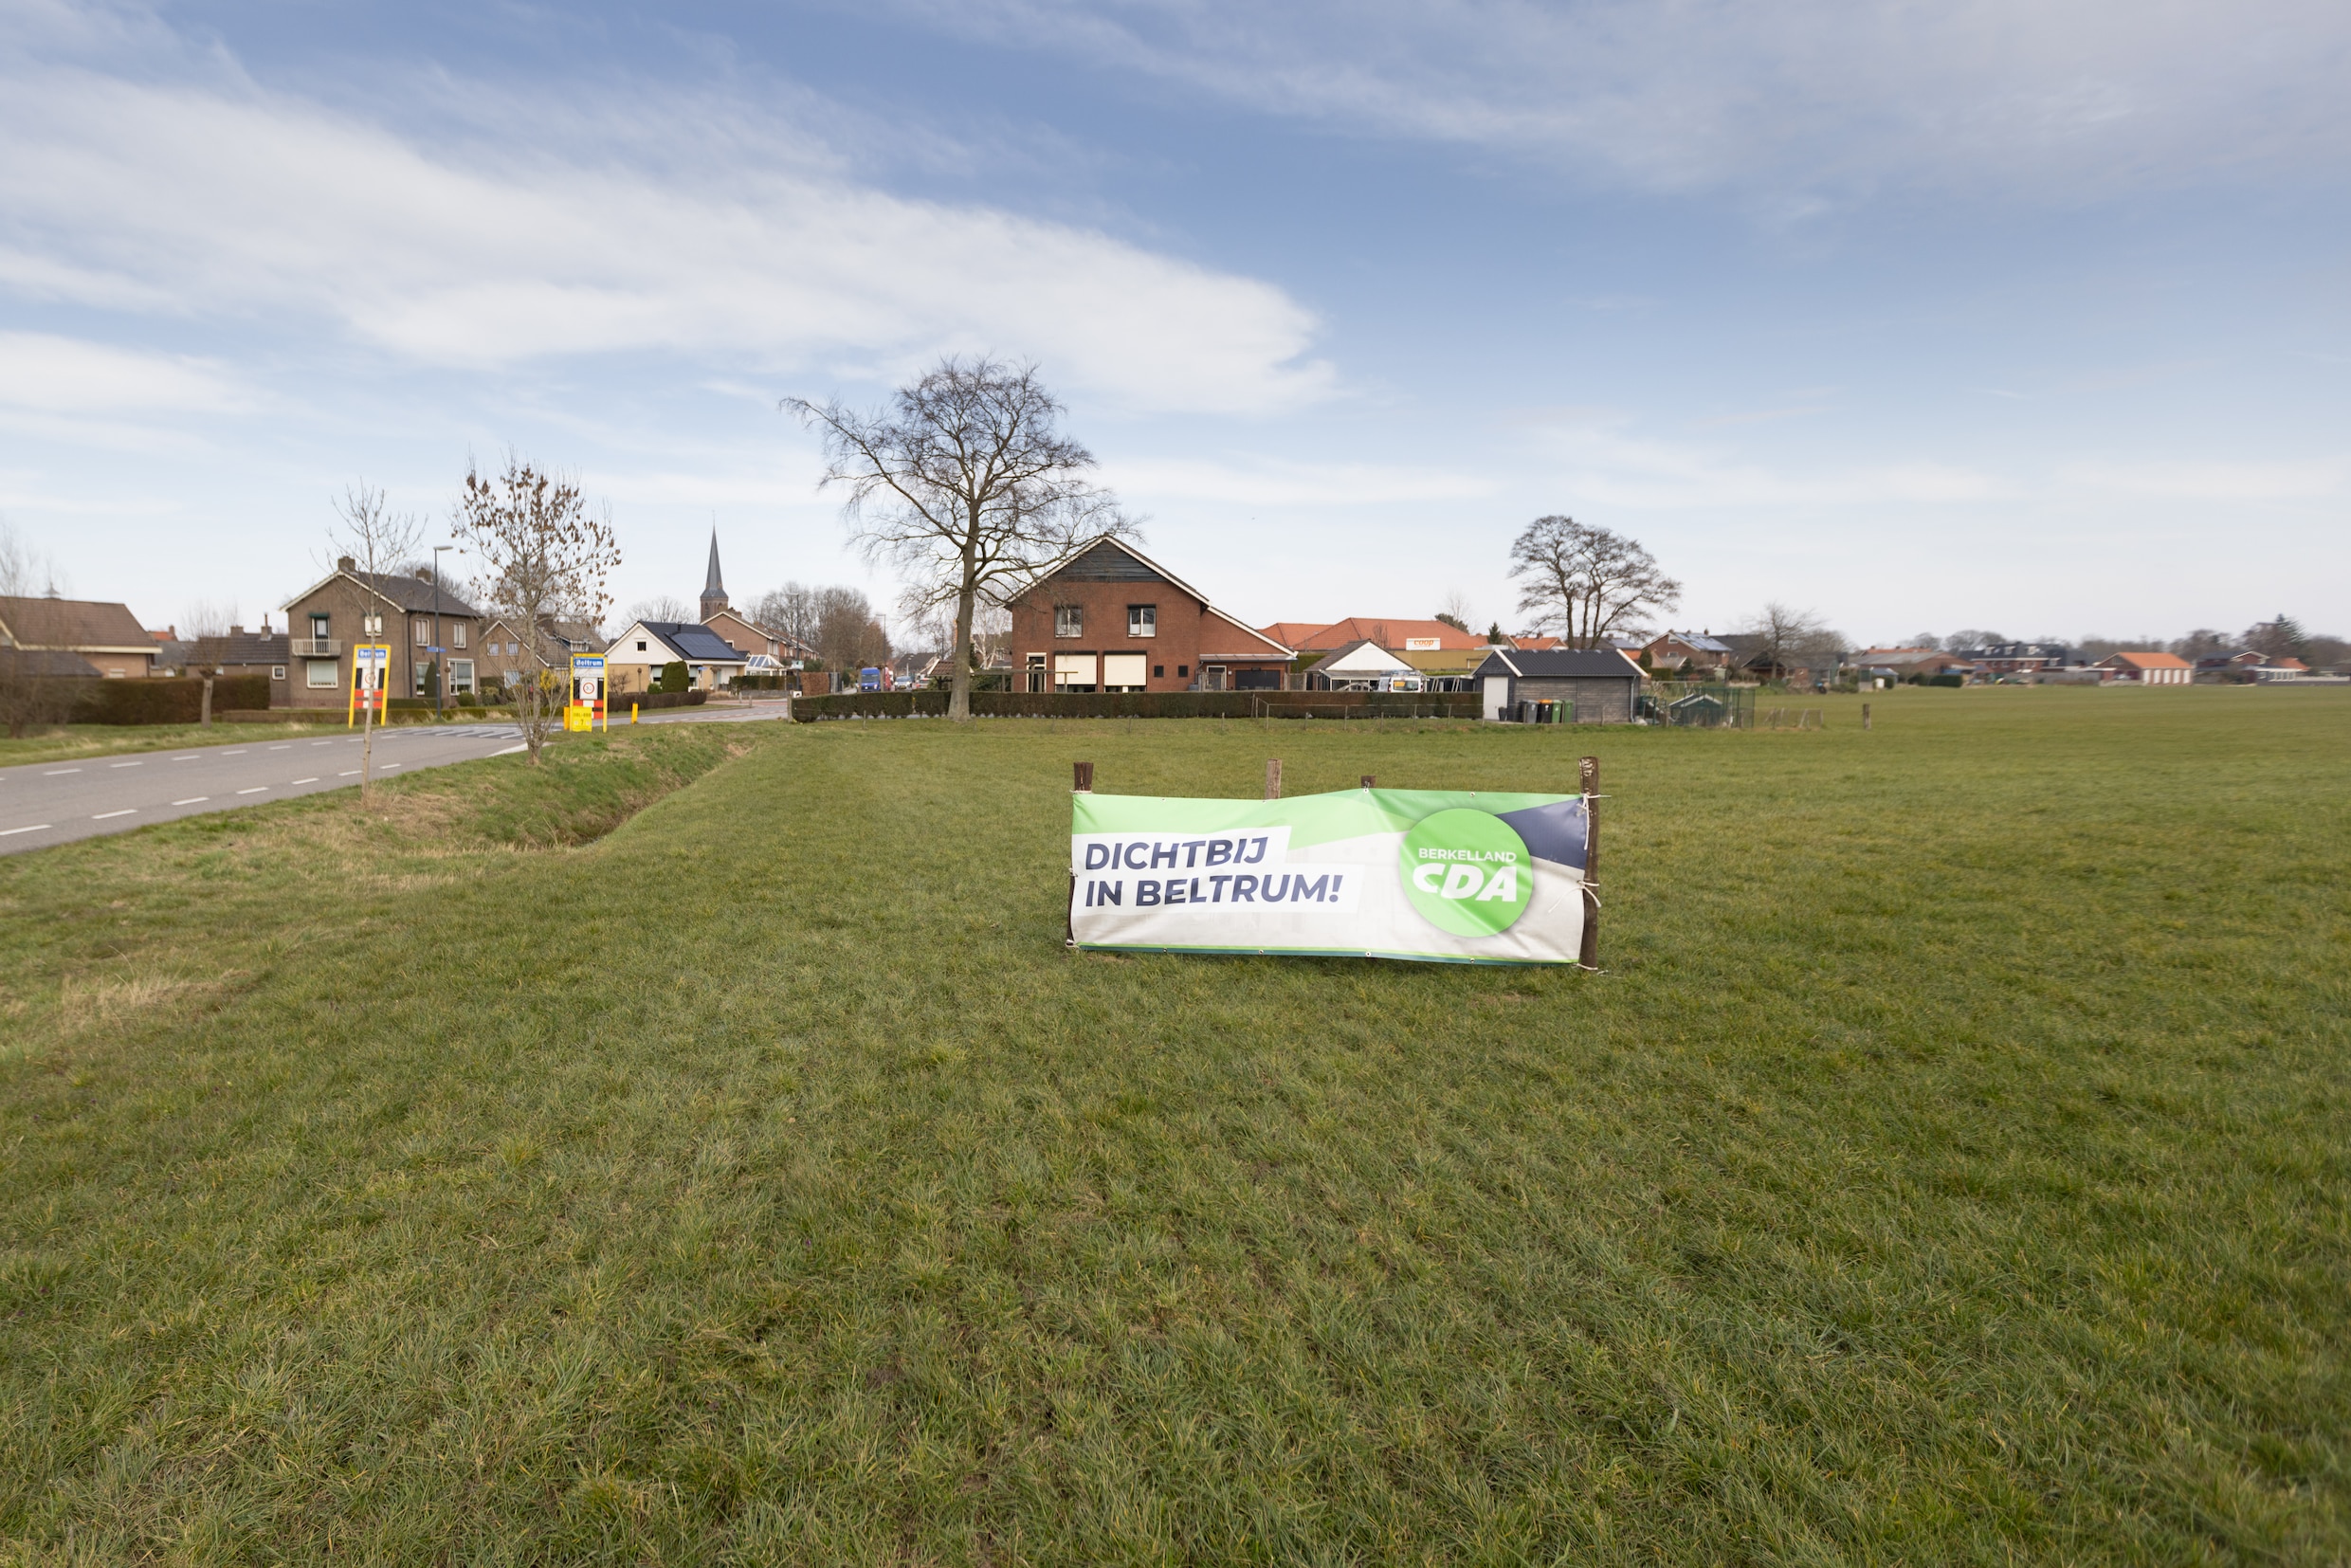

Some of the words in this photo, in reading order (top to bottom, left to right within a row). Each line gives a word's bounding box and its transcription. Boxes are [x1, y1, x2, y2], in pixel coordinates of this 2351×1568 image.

[1085, 836, 1269, 870] DICHTBIJ
[1418, 848, 1518, 863] BERKELLAND
[1085, 880, 1123, 907] IN
[1135, 874, 1343, 907] BELTRUM!
[1412, 863, 1518, 903] CDA
